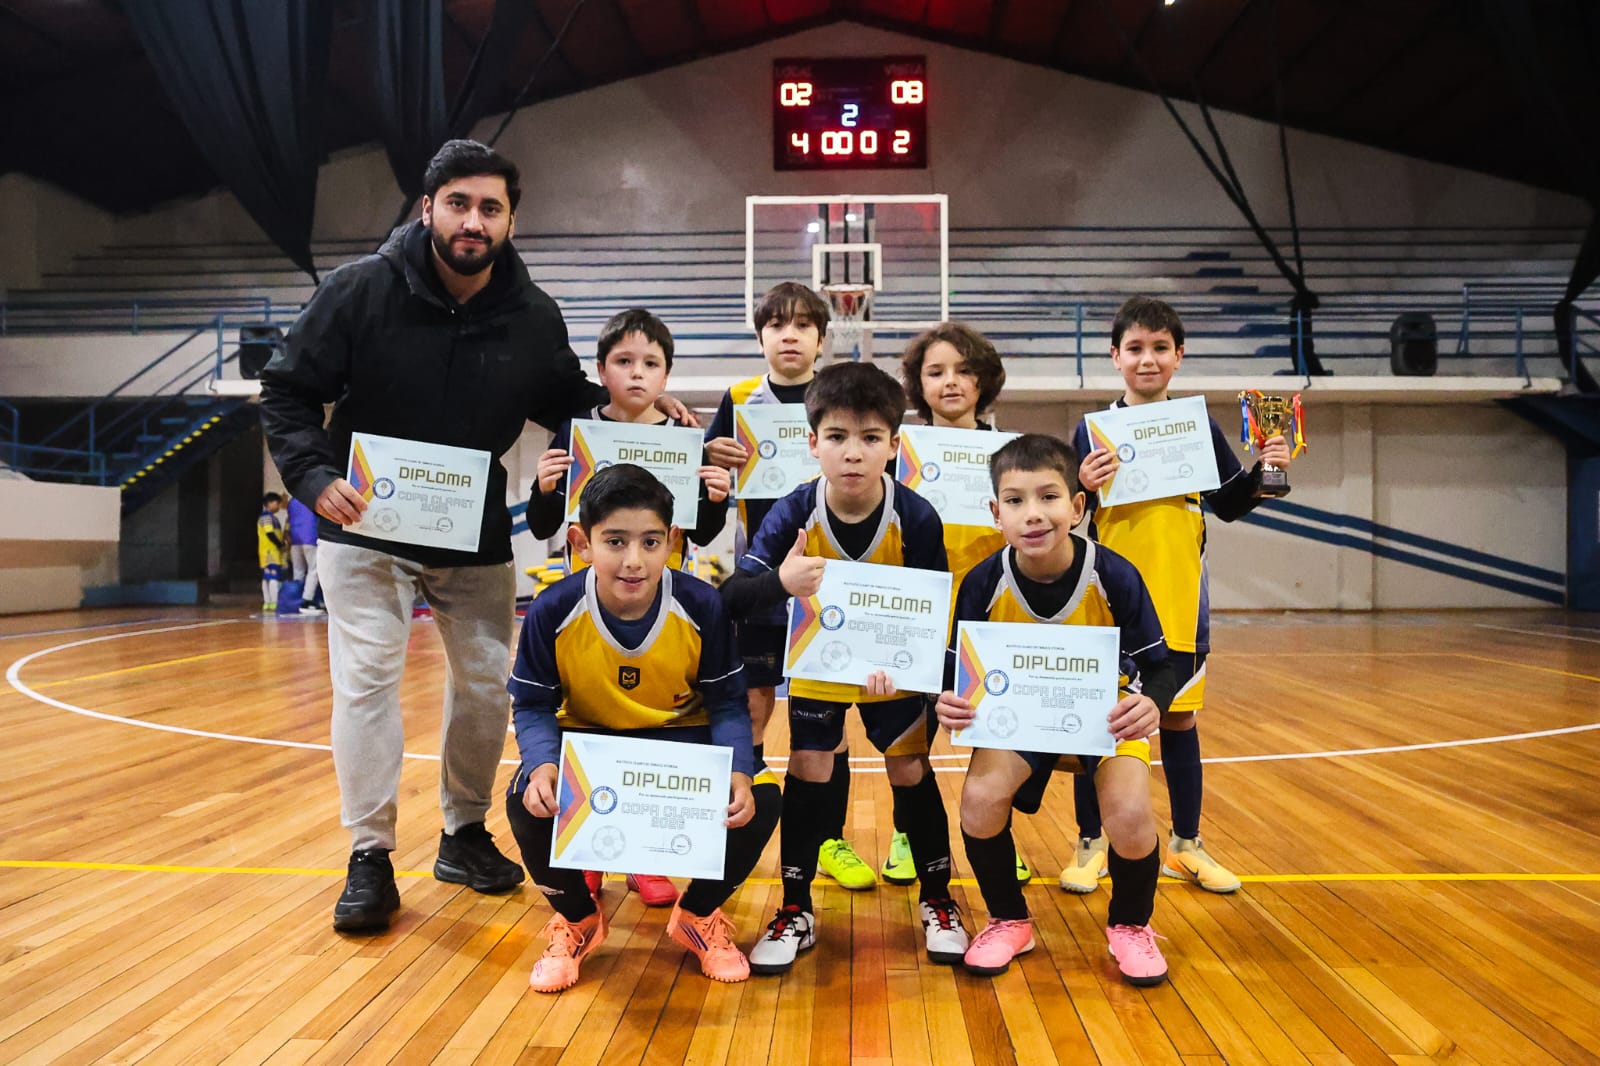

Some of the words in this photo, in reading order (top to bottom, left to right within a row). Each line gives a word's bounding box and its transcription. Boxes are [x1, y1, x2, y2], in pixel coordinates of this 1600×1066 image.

[780, 82, 813, 106] 02
[891, 80, 923, 104] 08
[841, 104, 859, 127] 2
[791, 132, 809, 155] 4
[892, 130, 910, 154] 2
[779, 427, 808, 438] DIPL
[1134, 420, 1197, 440] DIPLOMA
[618, 448, 688, 465] DIPLOMA
[944, 451, 992, 465] DIPLO
[399, 466, 472, 488] DIPLOMA
[398, 490, 428, 503] COPA
[849, 592, 932, 614] DIPLOMA
[848, 620, 884, 633] COPA
[887, 624, 936, 640] CLARET
[1013, 654, 1099, 673] DIPLOMA
[1012, 684, 1049, 696] COPA
[1053, 686, 1106, 700] CLARET
[622, 771, 711, 793] DIPLOMA
[621, 802, 660, 816] COPA
[663, 805, 718, 821] CLARET
